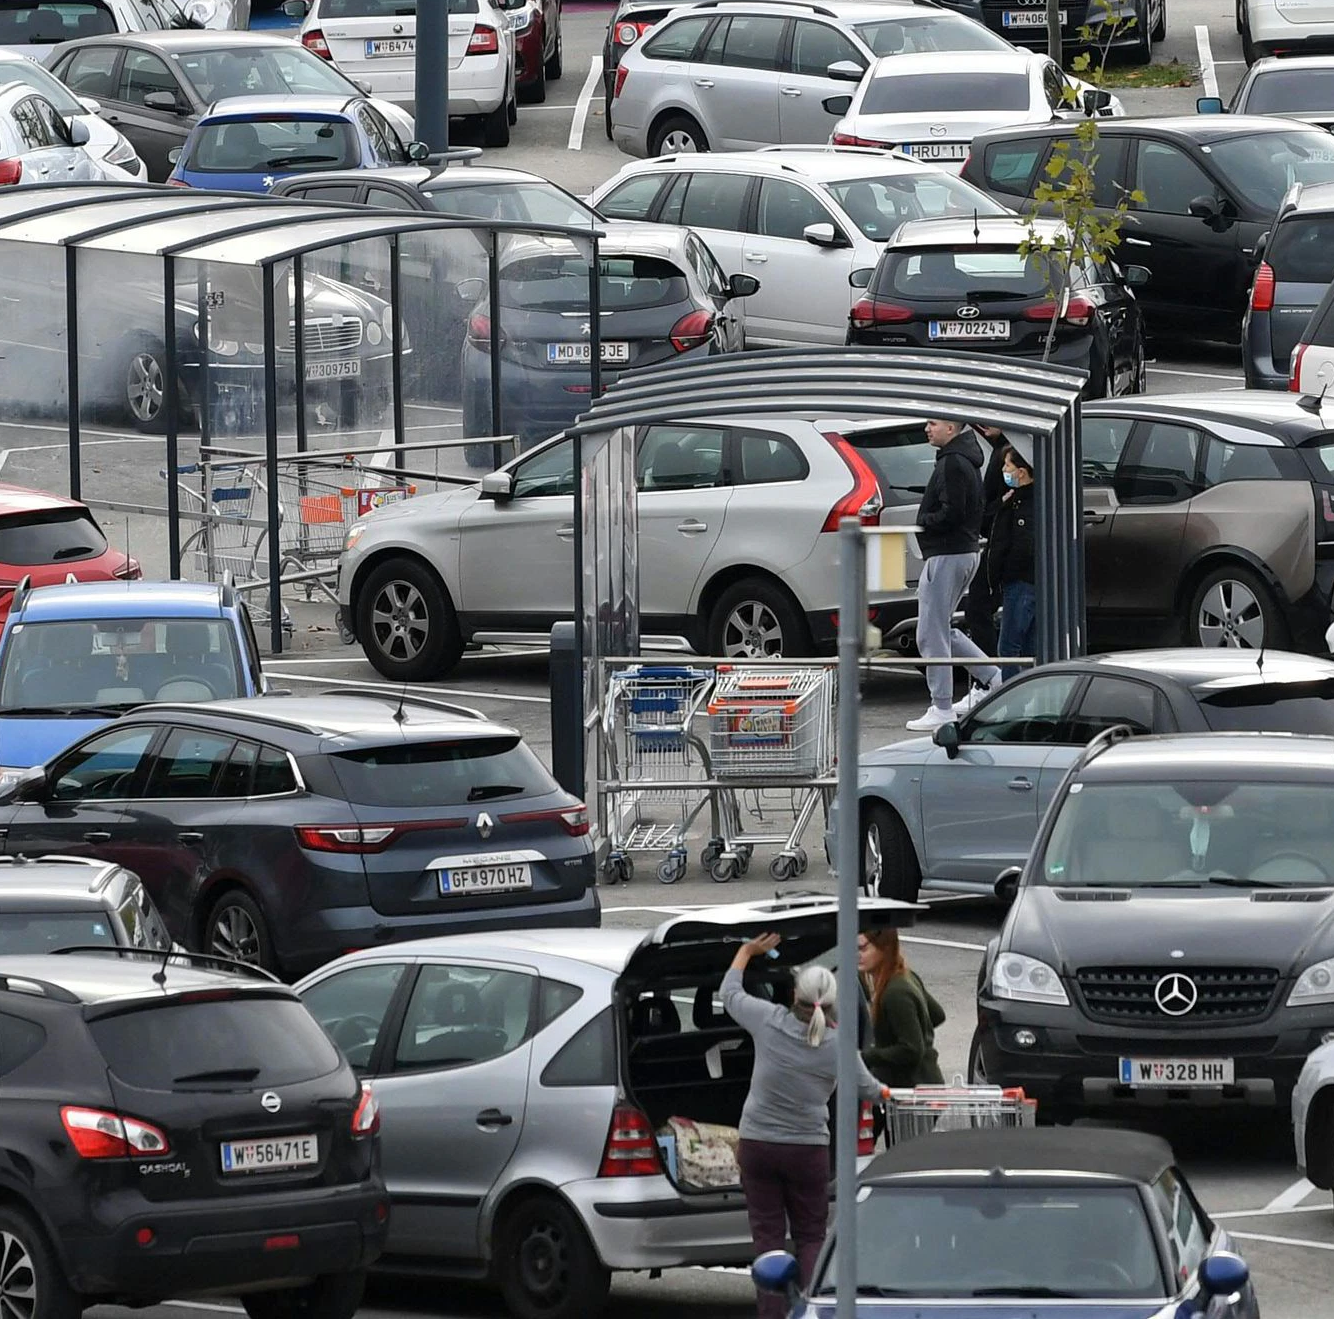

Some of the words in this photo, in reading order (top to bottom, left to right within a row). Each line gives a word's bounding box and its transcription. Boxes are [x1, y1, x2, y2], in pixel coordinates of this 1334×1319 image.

[374, 42, 381, 52] W
[912, 145, 941, 158] HRU
[939, 323, 949, 335] W
[958, 322, 997, 335] 70224
[998, 322, 1006, 334] J
[558, 345, 573, 359] MD
[609, 345, 623, 358] JE
[453, 871, 470, 888] GF
[480, 869, 506, 887] 970
[508, 867, 525, 884] HZ
[1140, 1064, 1152, 1082] W
[1166, 1063, 1199, 1082] 328
[1202, 1063, 1224, 1081] HH
[233, 1147, 245, 1164] W
[139, 1162, 186, 1175] QASHQAI
